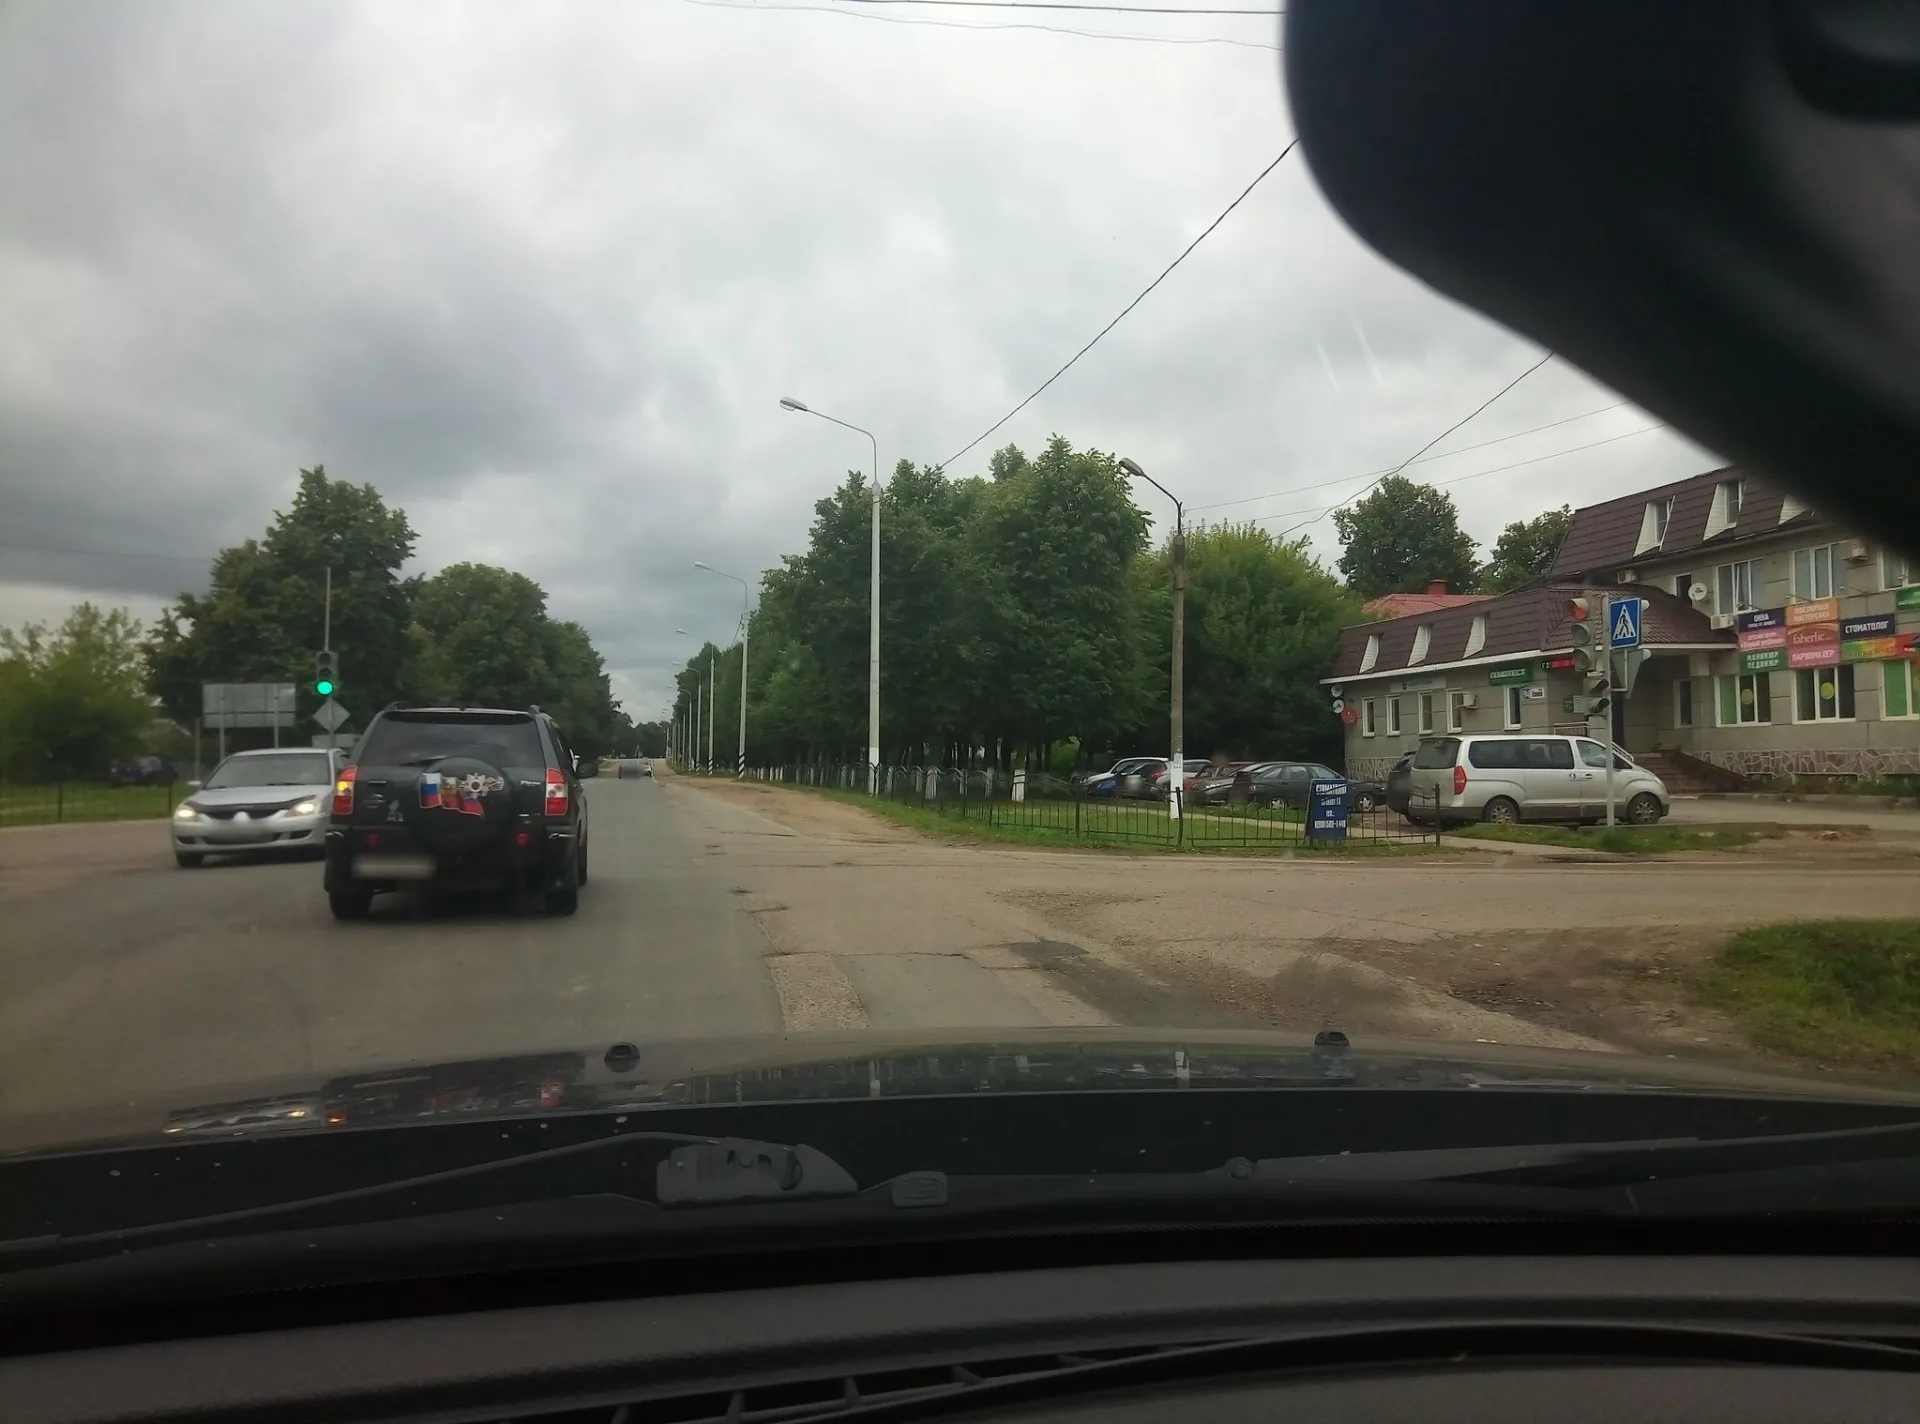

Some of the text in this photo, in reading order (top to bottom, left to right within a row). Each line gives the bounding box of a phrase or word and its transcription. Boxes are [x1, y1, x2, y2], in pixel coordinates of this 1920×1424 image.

[1845, 621, 1889, 634] СТОМАТОЛОГ
[1793, 631, 1824, 645] faberlic
[1746, 651, 1779, 661] МАНИКЮР
[1747, 660, 1779, 669] ПЕДИКЮР
